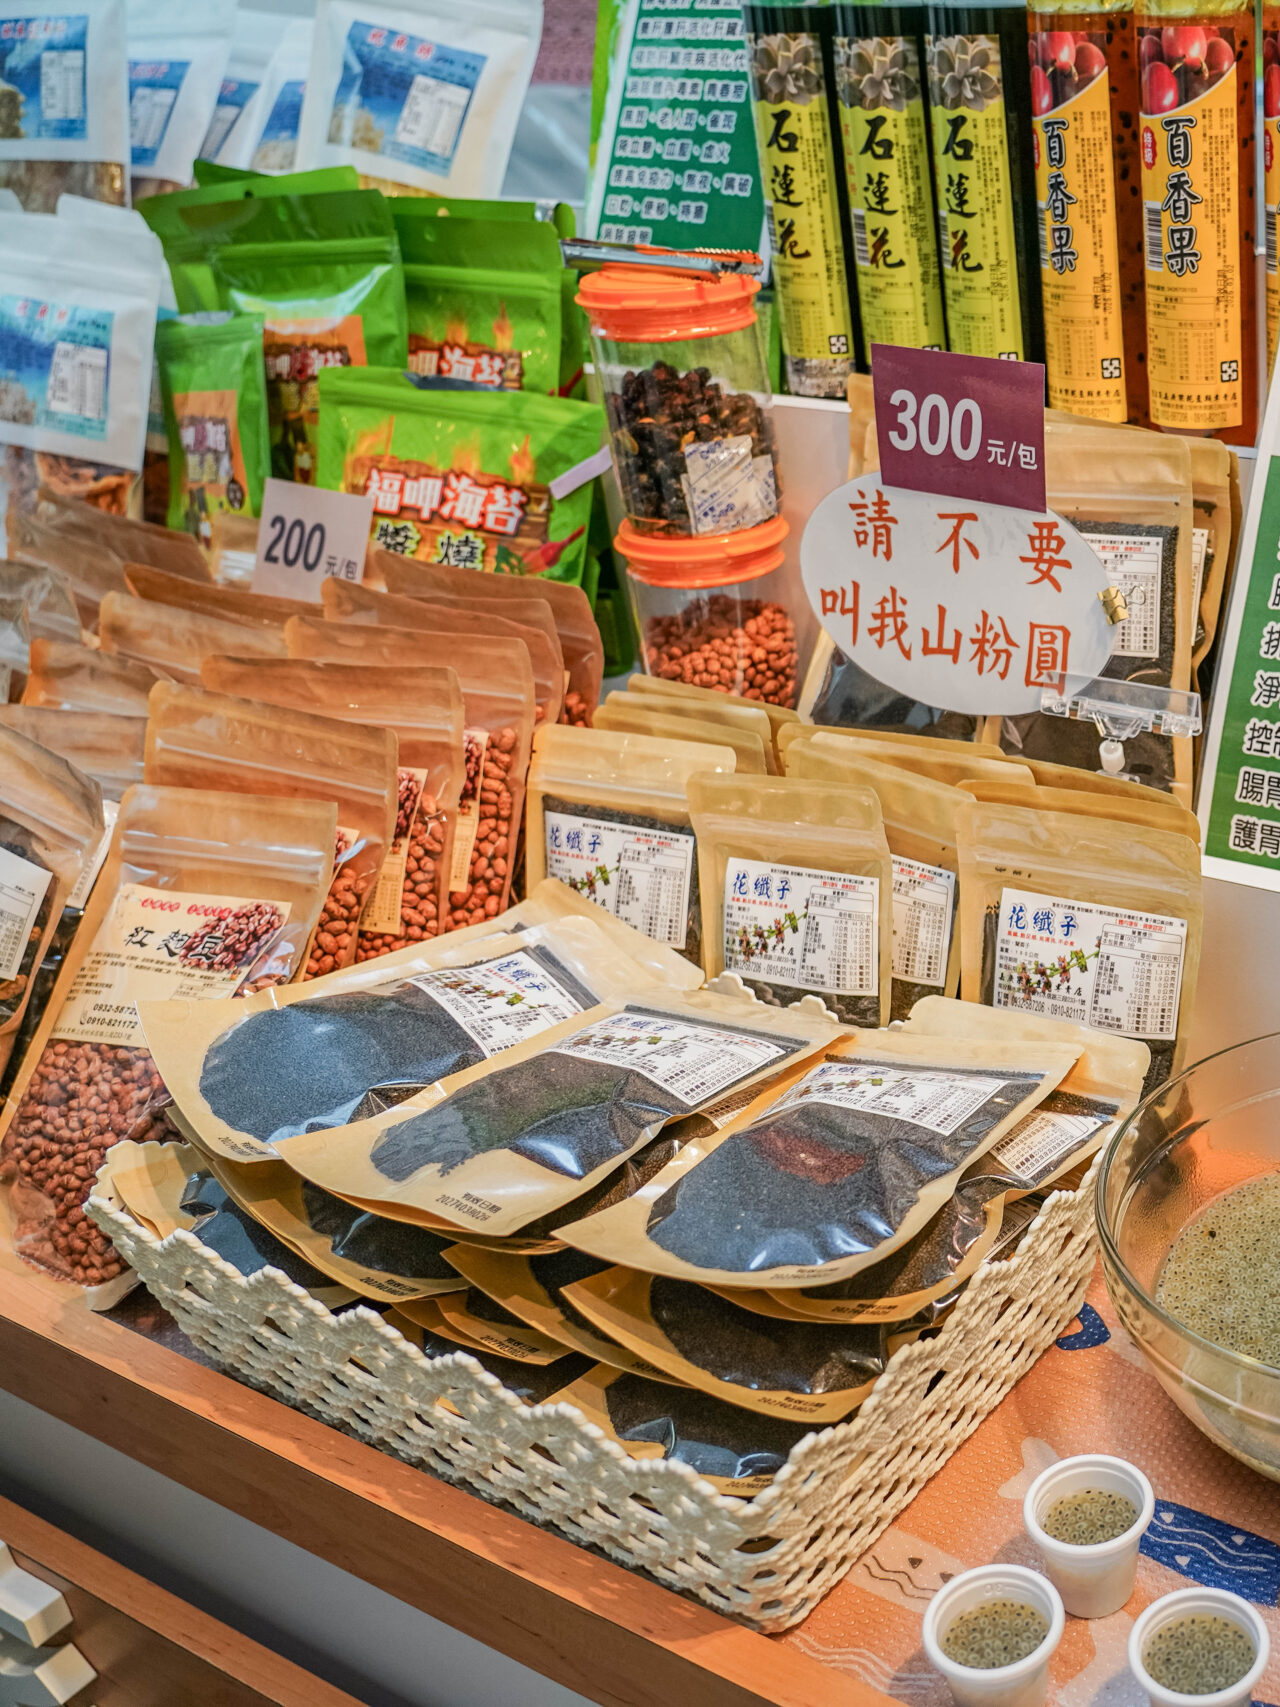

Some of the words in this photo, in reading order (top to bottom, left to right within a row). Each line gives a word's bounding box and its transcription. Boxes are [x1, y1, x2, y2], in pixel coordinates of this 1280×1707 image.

[767, 109, 811, 260] 石蓮花
[859, 115, 906, 269] 石蓮花
[942, 114, 984, 272] 石蓮花
[1041, 116, 1078, 275] 百香果
[1161, 116, 1203, 277] 百香果
[366, 468, 528, 536] 福呷海苔
[848, 488, 1073, 593] 請不要
[819, 580, 1072, 697] 叫我山粉圓
[550, 825, 603, 855] 花纖子
[733, 872, 791, 900] 花纖子
[1008, 904, 1078, 938] 花纖子
[86, 1015, 139, 1029] 0910-821172
